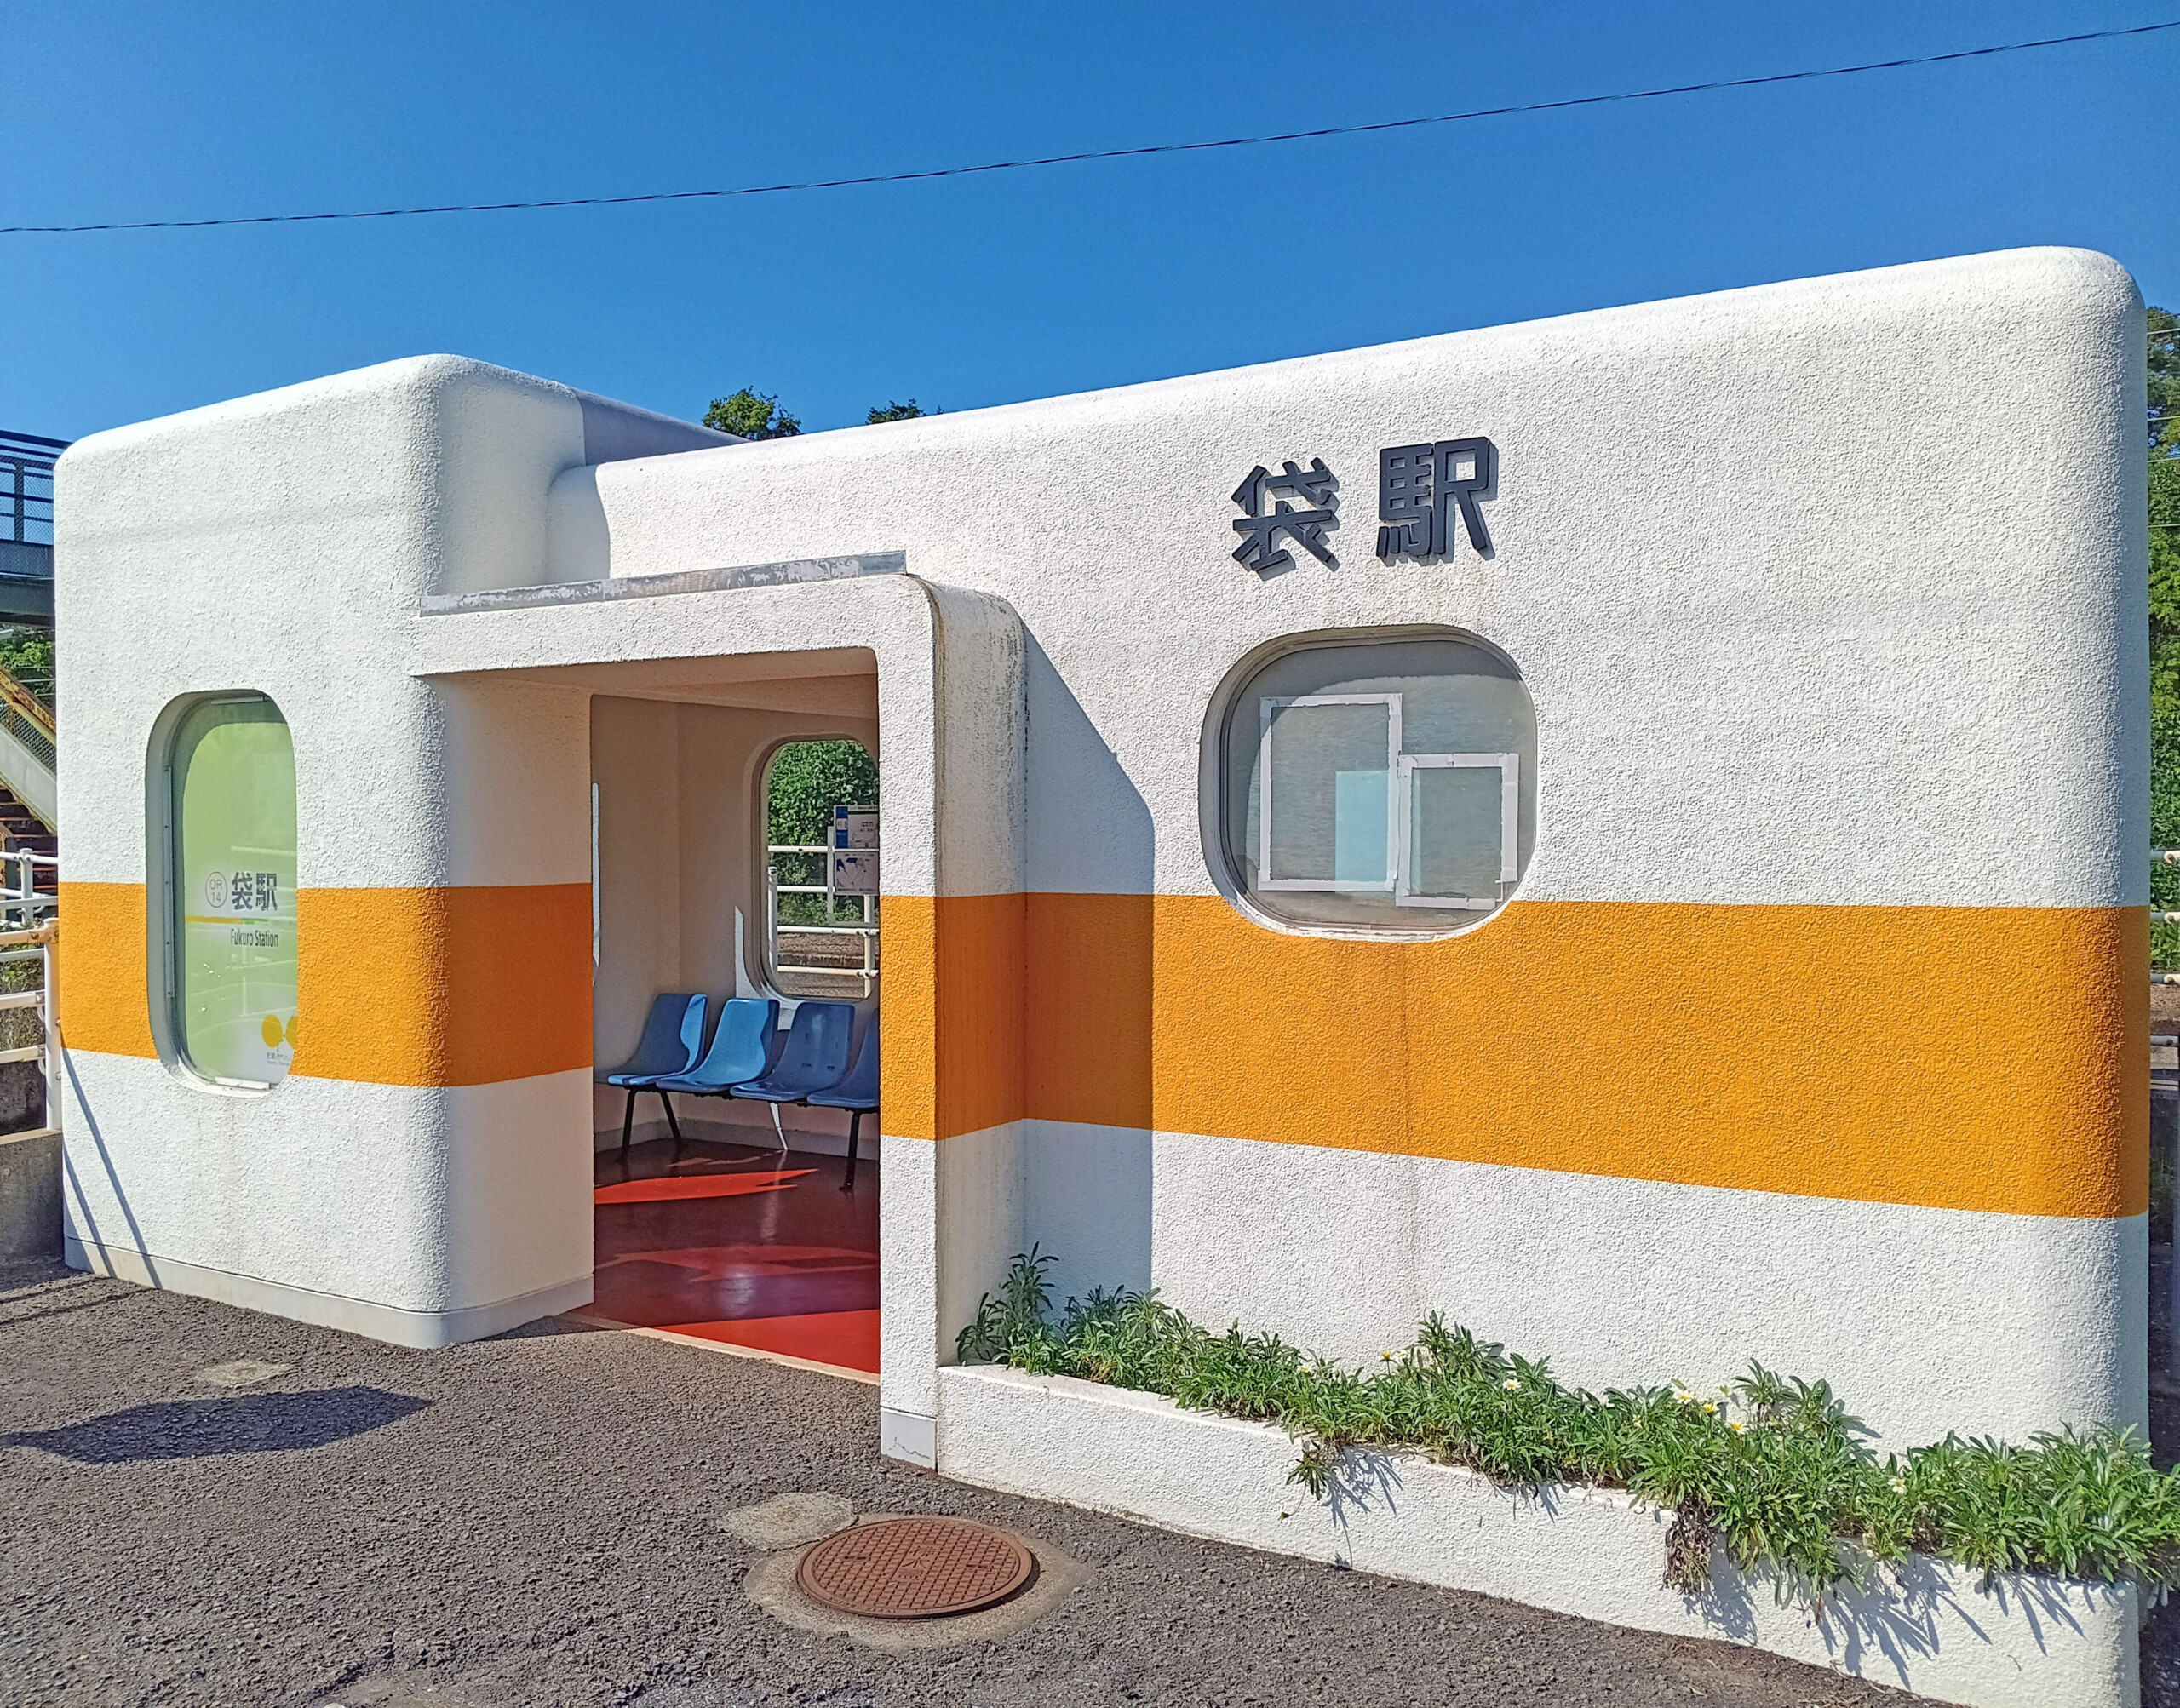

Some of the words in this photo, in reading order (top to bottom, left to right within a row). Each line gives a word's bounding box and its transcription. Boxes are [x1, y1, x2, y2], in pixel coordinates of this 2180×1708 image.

[1231, 437, 1498, 581] 袋駅
[209, 879, 222, 890] OR
[232, 872, 278, 911] 袋駅
[212, 892, 221, 903] 14
[231, 928, 254, 946] Fukuro
[255, 930, 278, 948] Station
